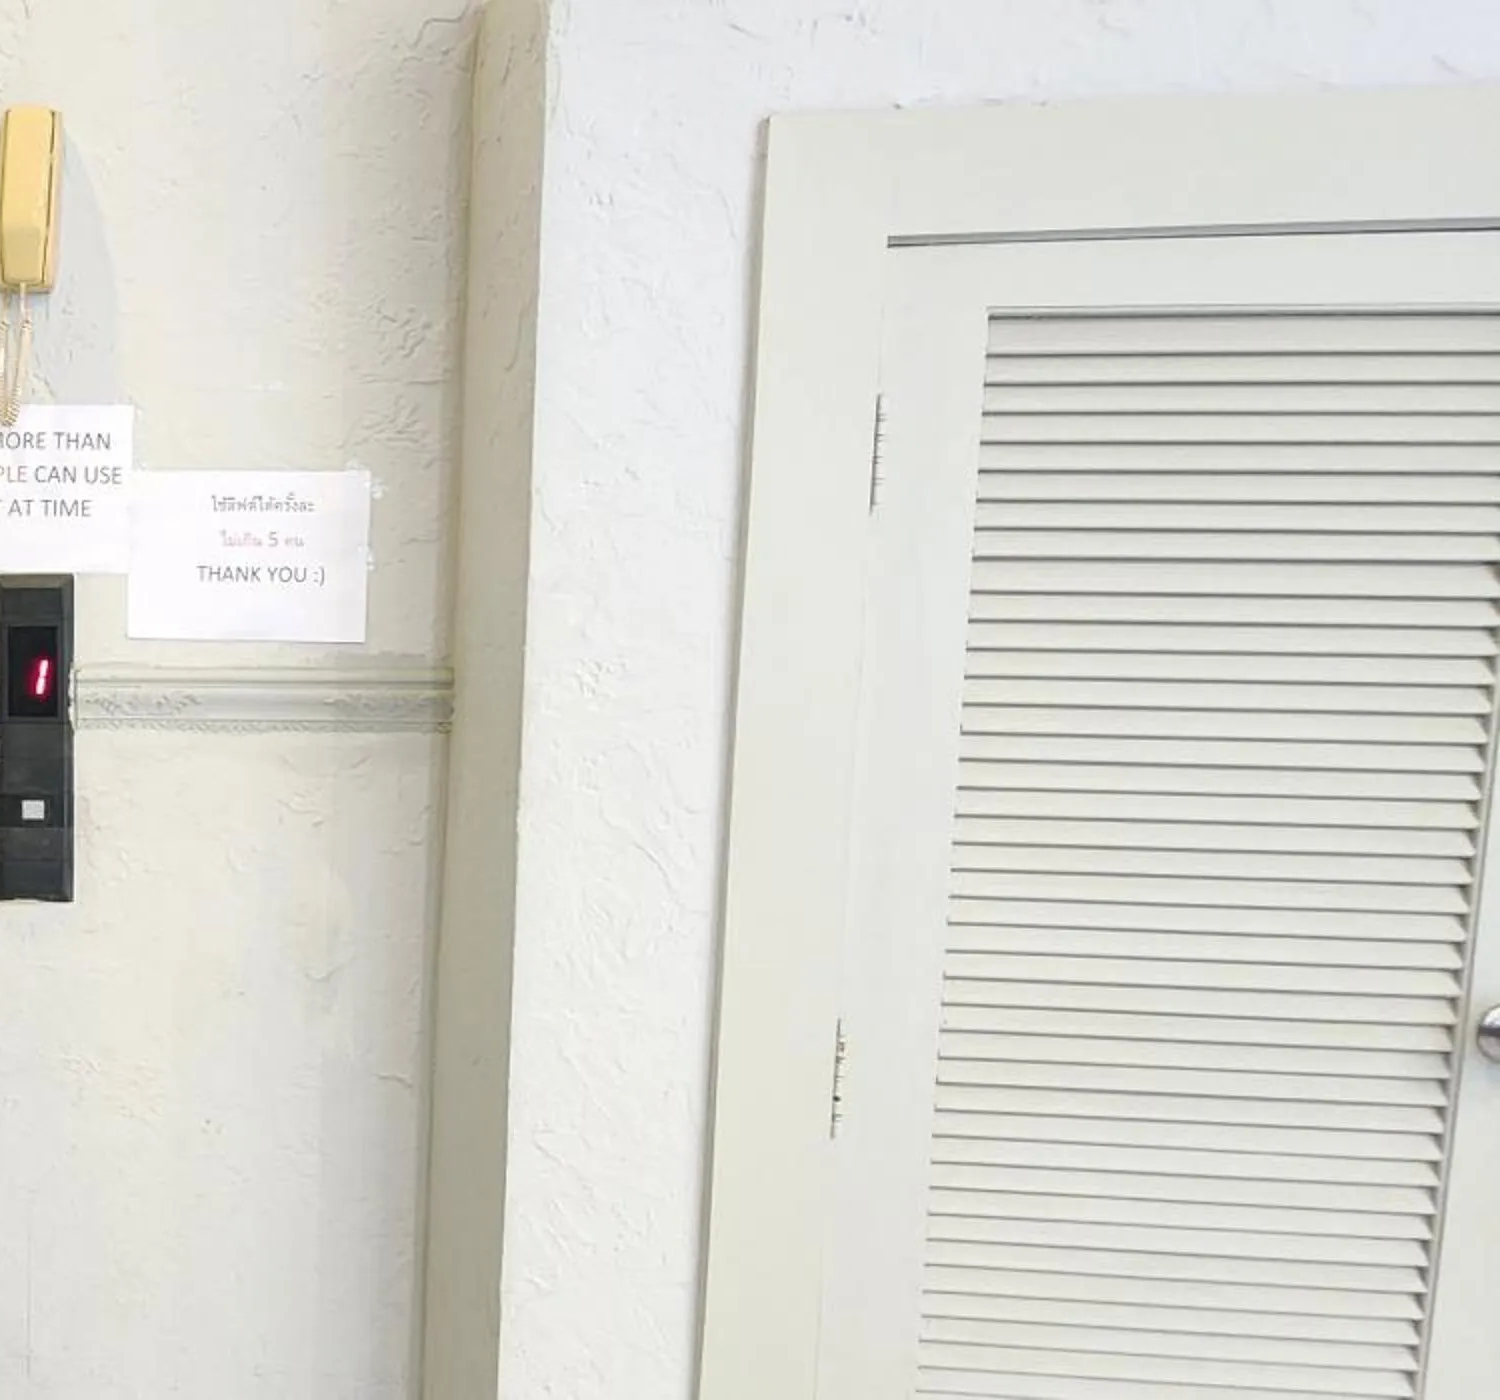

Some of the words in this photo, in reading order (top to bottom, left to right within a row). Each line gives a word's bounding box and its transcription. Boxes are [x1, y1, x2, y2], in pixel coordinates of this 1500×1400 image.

[53, 431, 111, 451] THAN
[34, 464, 77, 484] CAN
[84, 466, 123, 485] USE
[8, 499, 36, 517] AT
[40, 499, 93, 518] TIME
[268, 531, 279, 548] 5
[196, 565, 261, 583] THANK
[266, 565, 308, 584] YOU
[36, 658, 50, 696] 1
